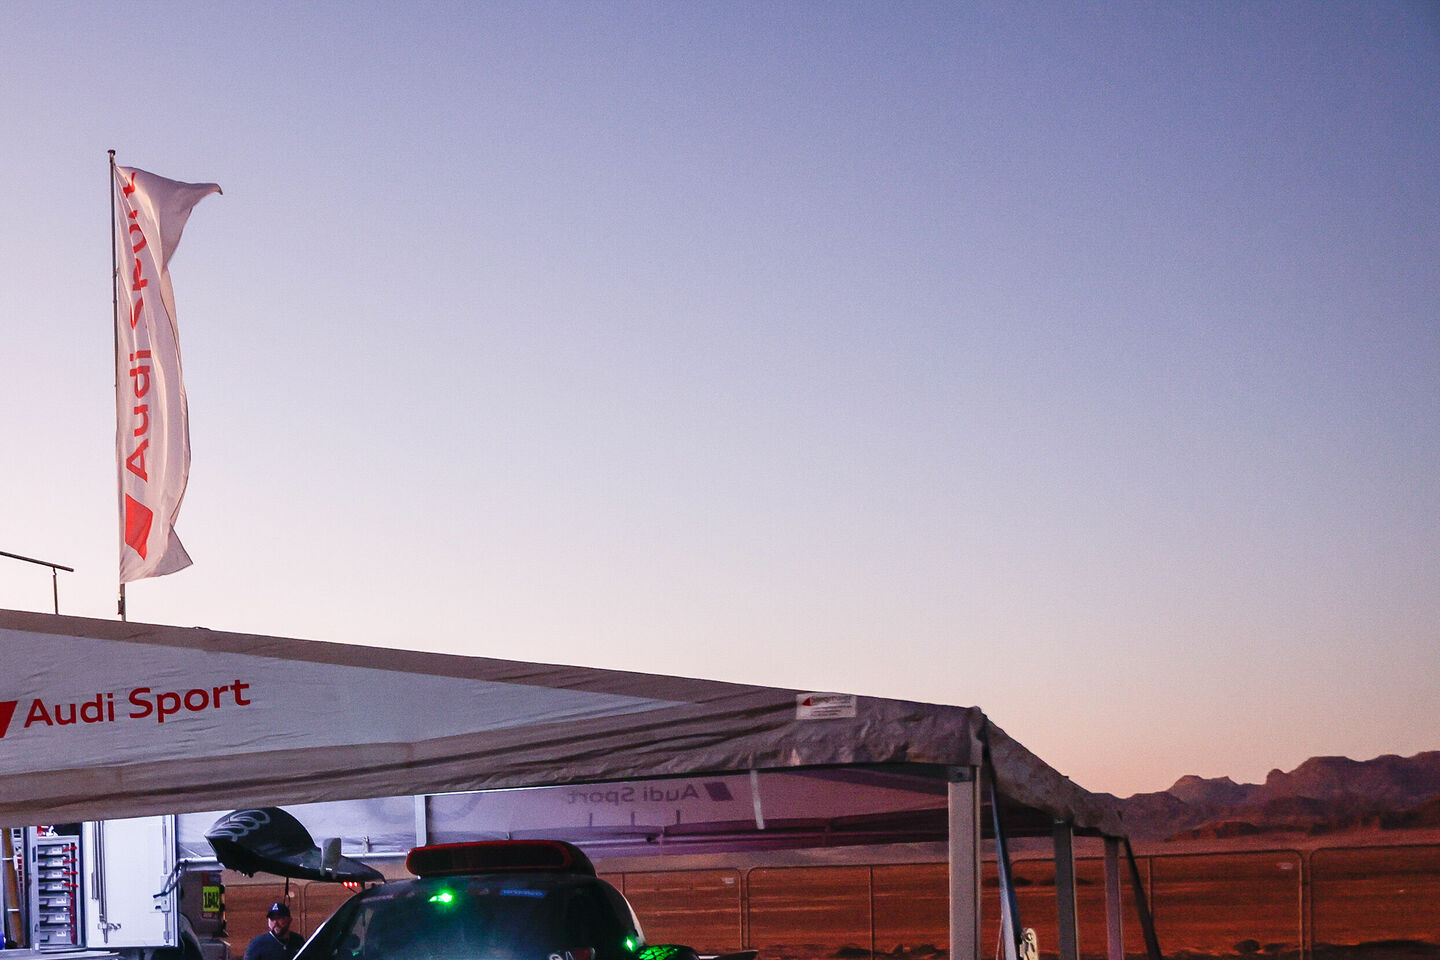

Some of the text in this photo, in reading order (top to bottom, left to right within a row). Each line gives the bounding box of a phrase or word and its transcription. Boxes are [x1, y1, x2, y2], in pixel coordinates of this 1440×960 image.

[125, 349, 152, 482] Audi
[24, 679, 251, 728] Audi Sport
